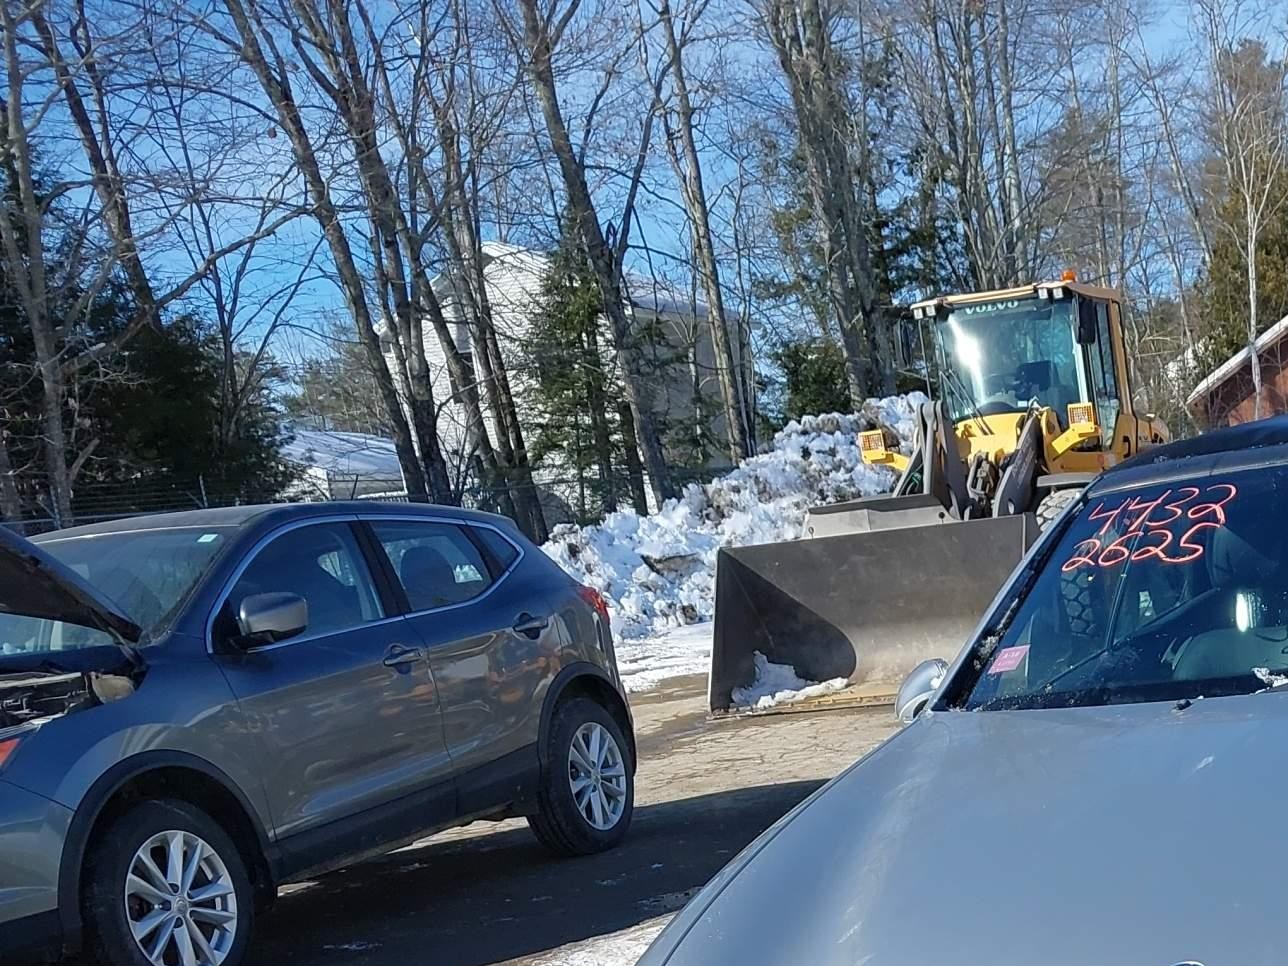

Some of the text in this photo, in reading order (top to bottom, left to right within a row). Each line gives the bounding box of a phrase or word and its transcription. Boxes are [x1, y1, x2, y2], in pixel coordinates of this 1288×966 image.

[965, 300, 1019, 315] VOLVO
[1088, 484, 1238, 536] 4432
[1061, 522, 1225, 572] 2625
